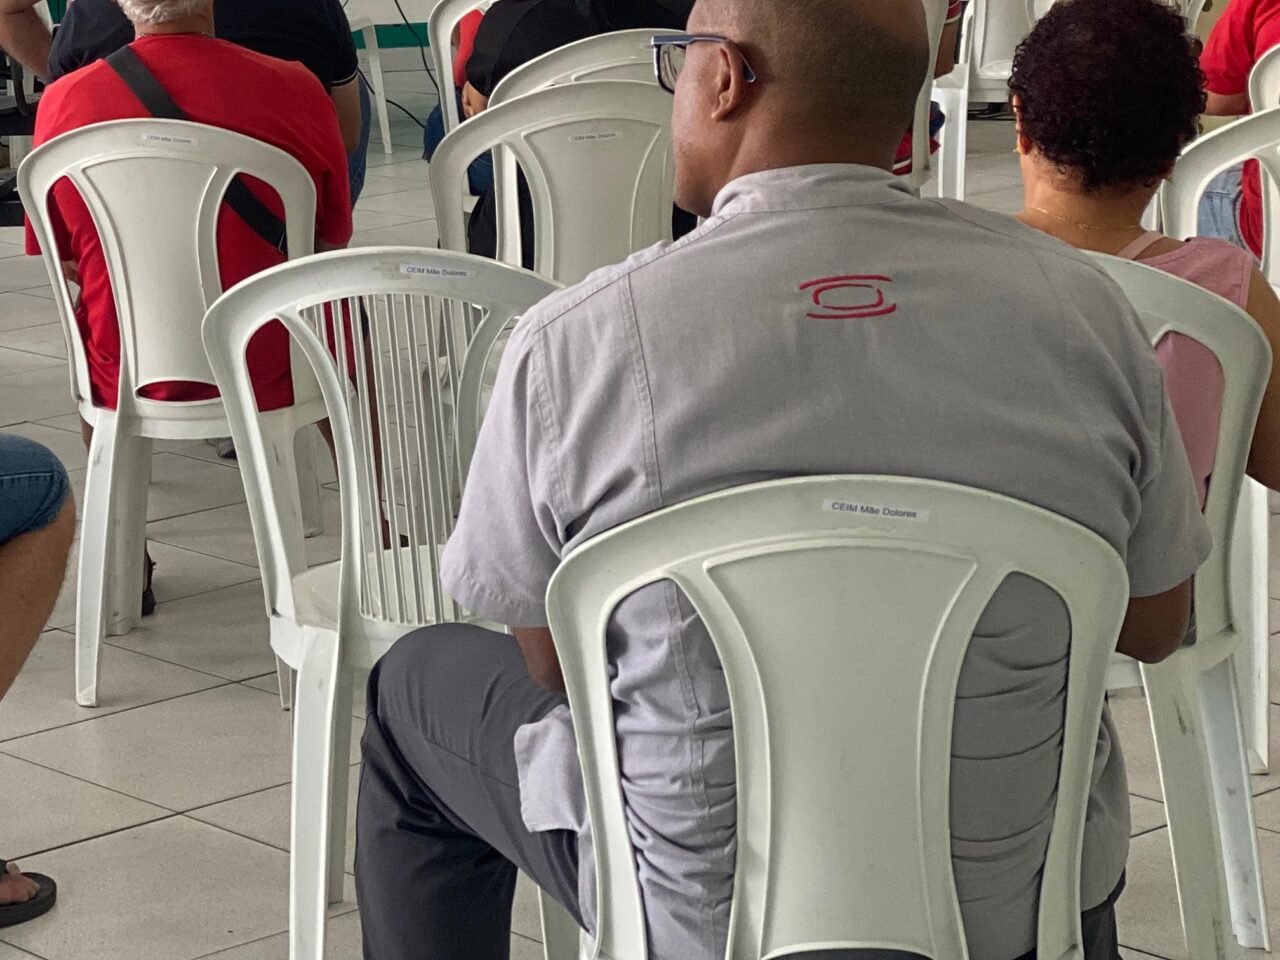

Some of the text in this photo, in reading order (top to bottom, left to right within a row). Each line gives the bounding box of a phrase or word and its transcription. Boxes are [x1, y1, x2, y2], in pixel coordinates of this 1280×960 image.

[406, 266, 425, 274] CEIM
[442, 269, 467, 277] Dolores
[831, 502, 917, 518] CEIM Mãe Dolores
